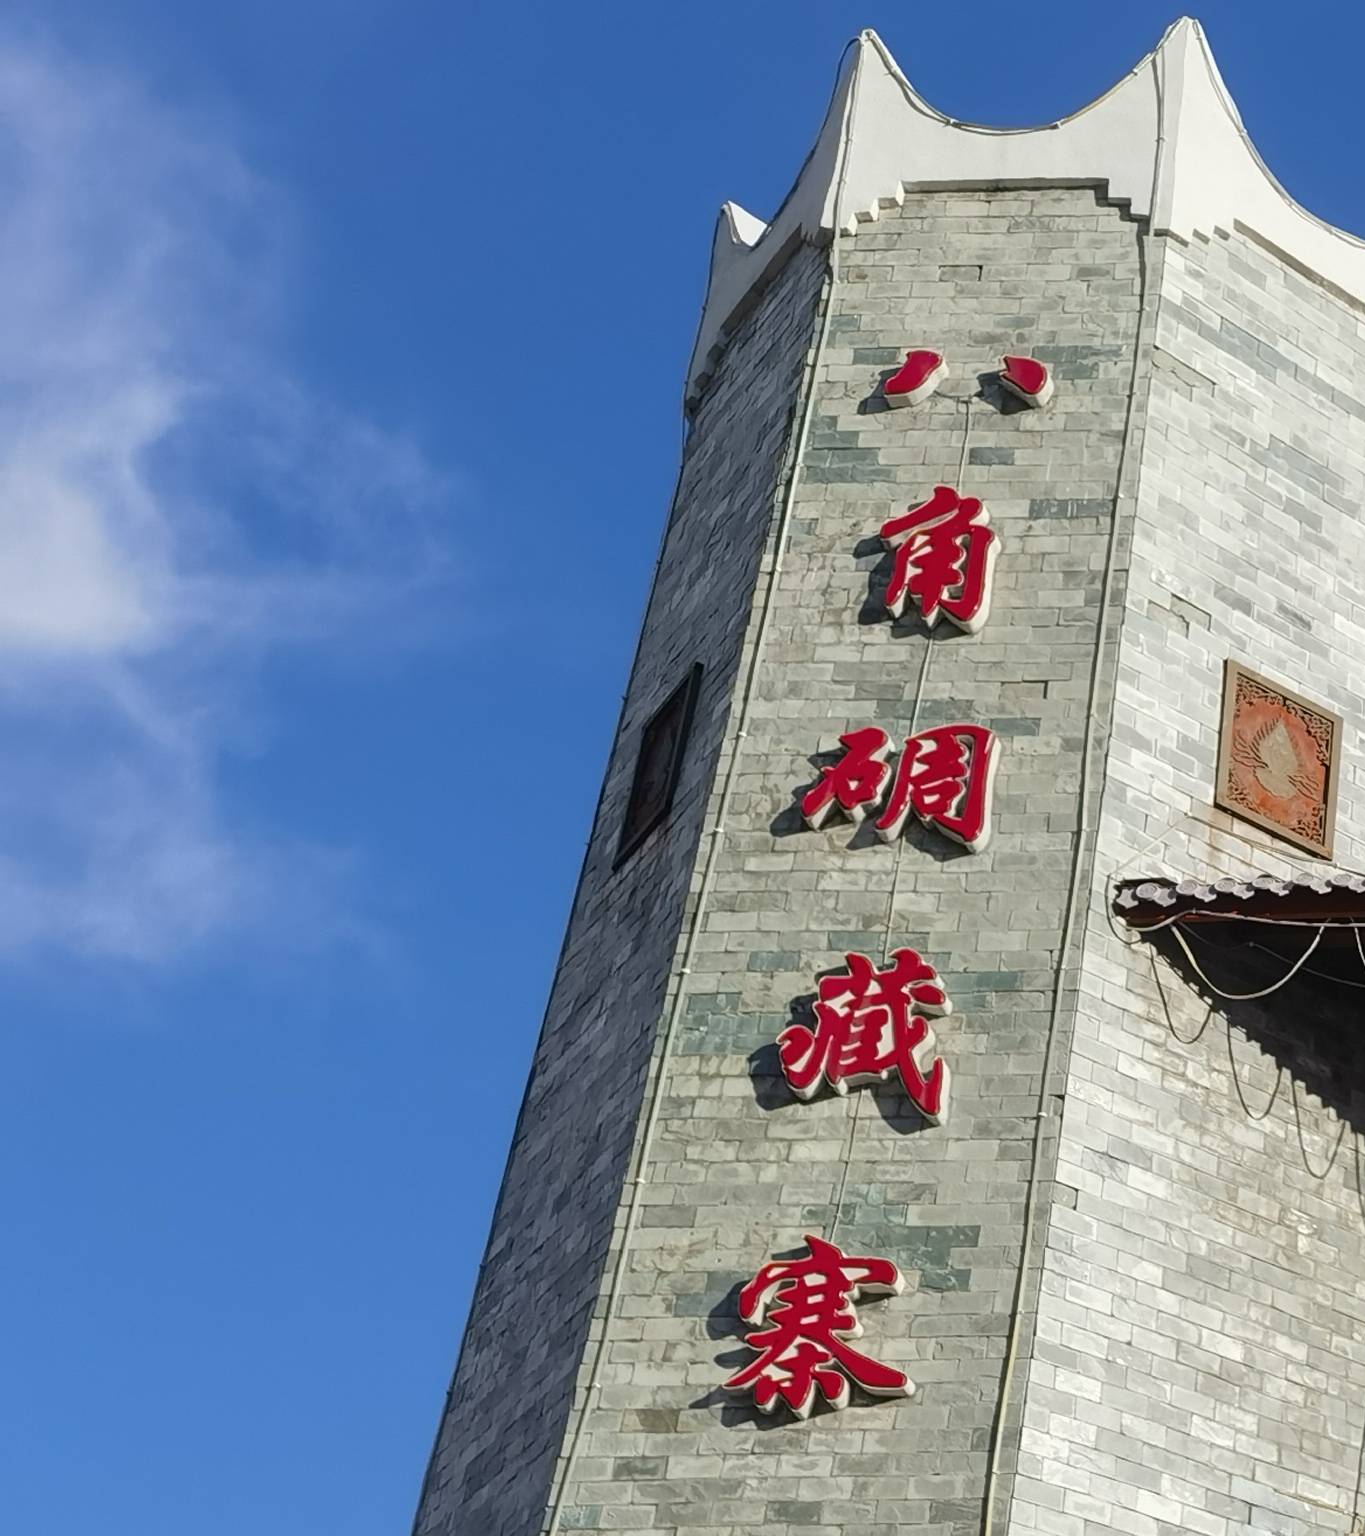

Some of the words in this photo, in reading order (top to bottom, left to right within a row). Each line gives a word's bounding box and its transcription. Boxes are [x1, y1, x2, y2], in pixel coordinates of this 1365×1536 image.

[725, 348, 1052, 1416] 八角碉藏寨
